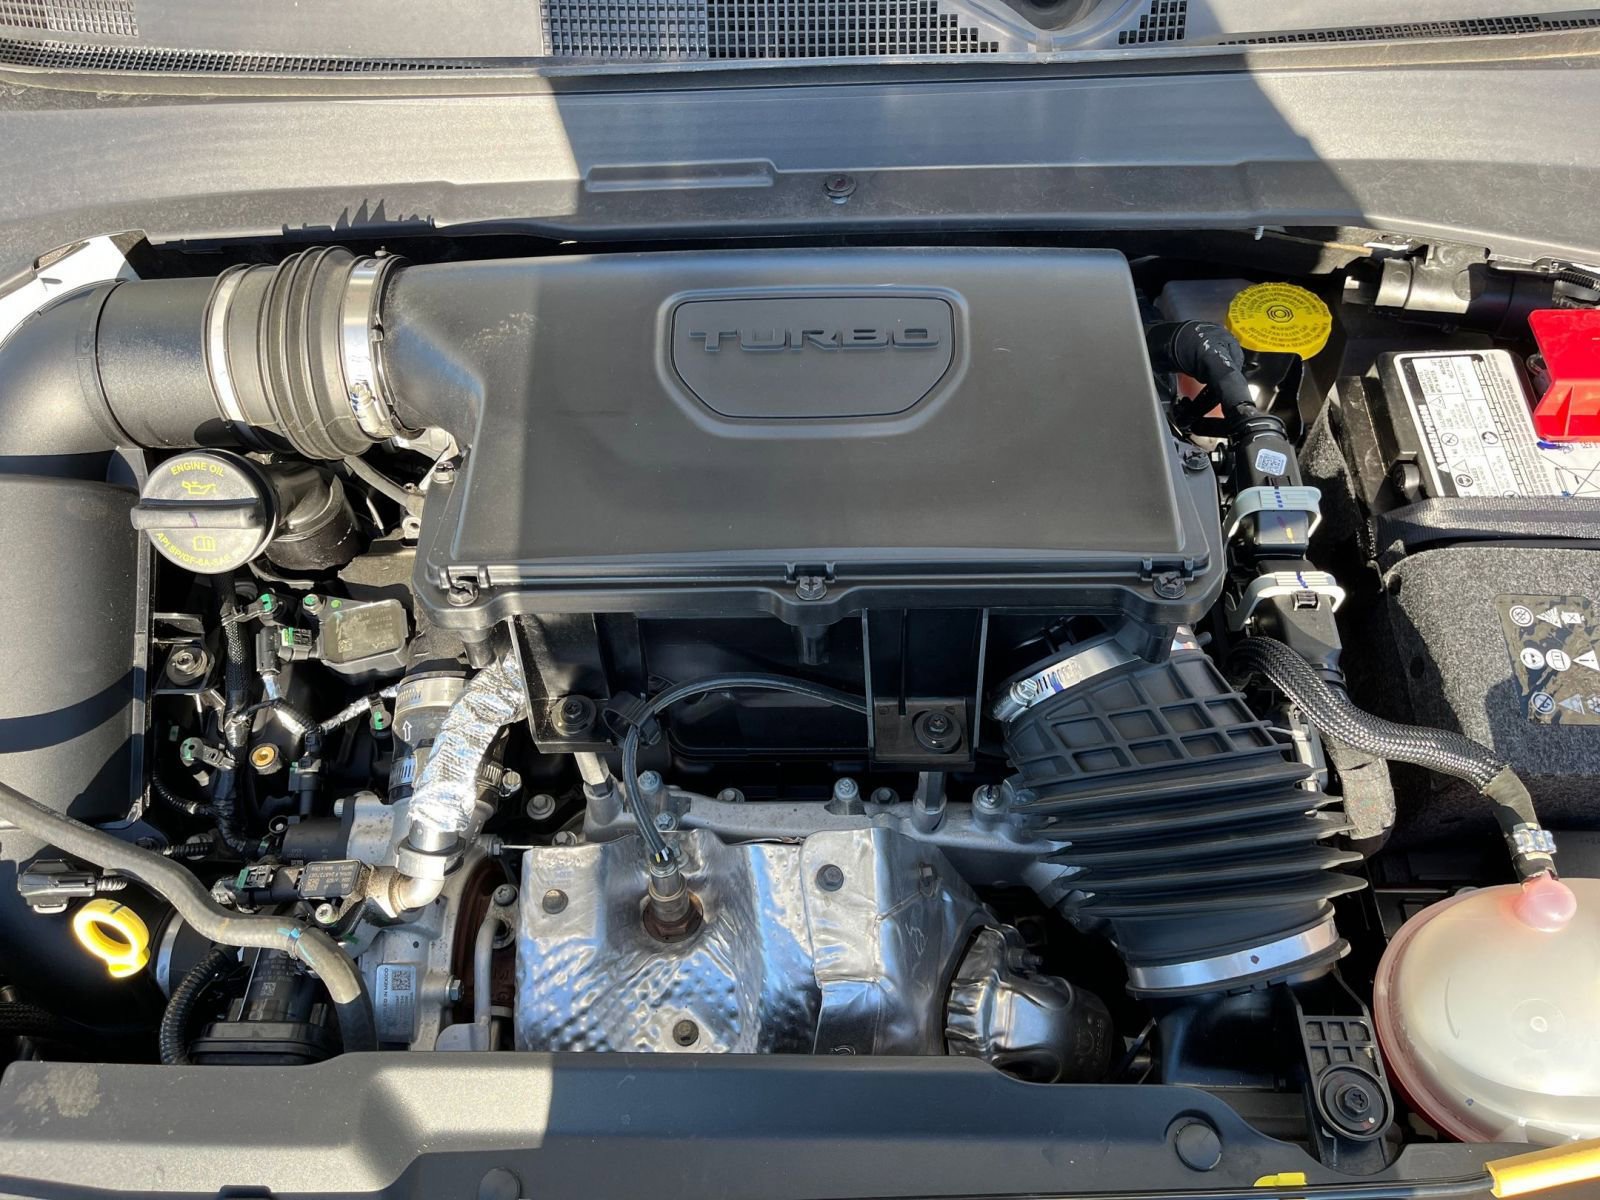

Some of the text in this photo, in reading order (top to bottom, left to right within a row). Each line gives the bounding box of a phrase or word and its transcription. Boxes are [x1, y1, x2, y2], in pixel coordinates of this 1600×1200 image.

[689, 327, 941, 352] TURBO
[170, 461, 225, 477] ENGINE OIL
[156, 532, 168, 547] API
